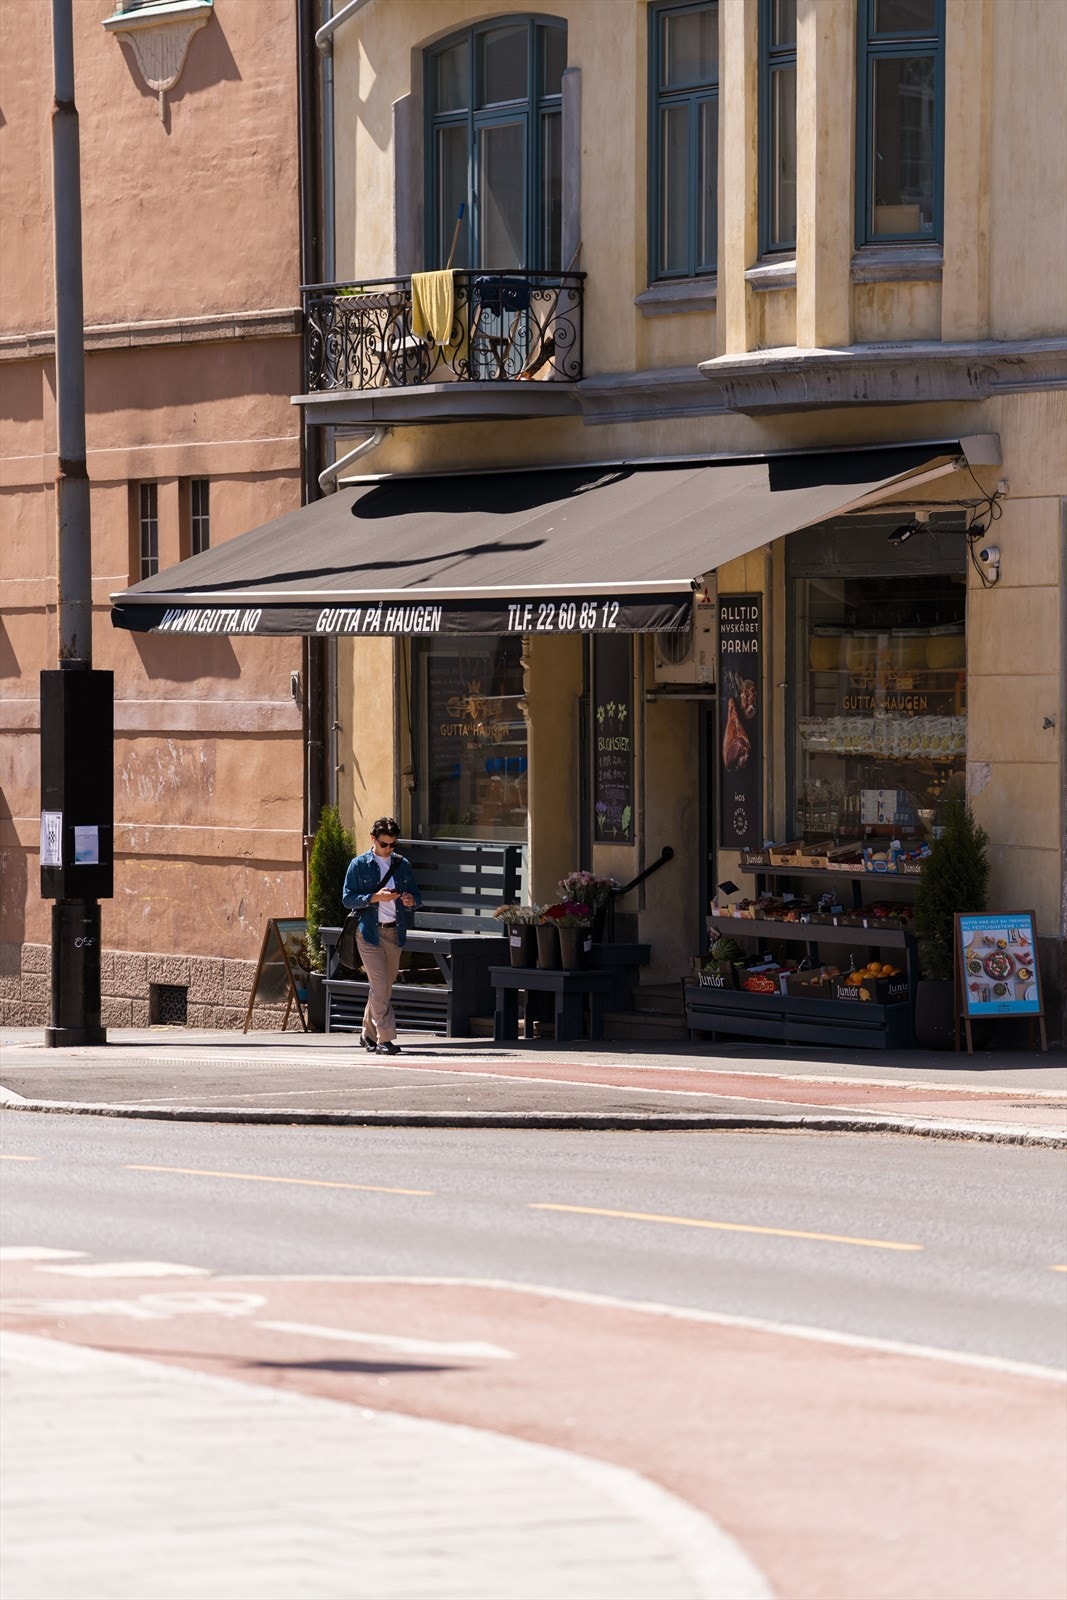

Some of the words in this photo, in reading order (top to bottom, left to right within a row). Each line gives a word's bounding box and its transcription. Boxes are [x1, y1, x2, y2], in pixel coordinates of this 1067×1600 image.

[158, 608, 263, 632] WWW.GUTTA.NO
[315, 607, 362, 632] GUTTA
[361, 601, 384, 632] PÅ
[383, 606, 442, 632] HAUGEN
[507, 604, 533, 631] TLF.
[536, 603, 556, 630] 22
[558, 602, 577, 630] 60
[579, 602, 598, 629] 85
[601, 601, 620, 628] 12
[720, 606, 759, 620] ALLTID
[720, 621, 759, 633] NYSKÅRET
[721, 639, 758, 653] PARMA
[842, 696, 876, 710] GUTTA
[885, 695, 928, 710] HAUGEN
[440, 723, 468, 736] GUTTA
[473, 723, 509, 737] HAUGEN
[597, 736, 630, 751] BLOMSTER
